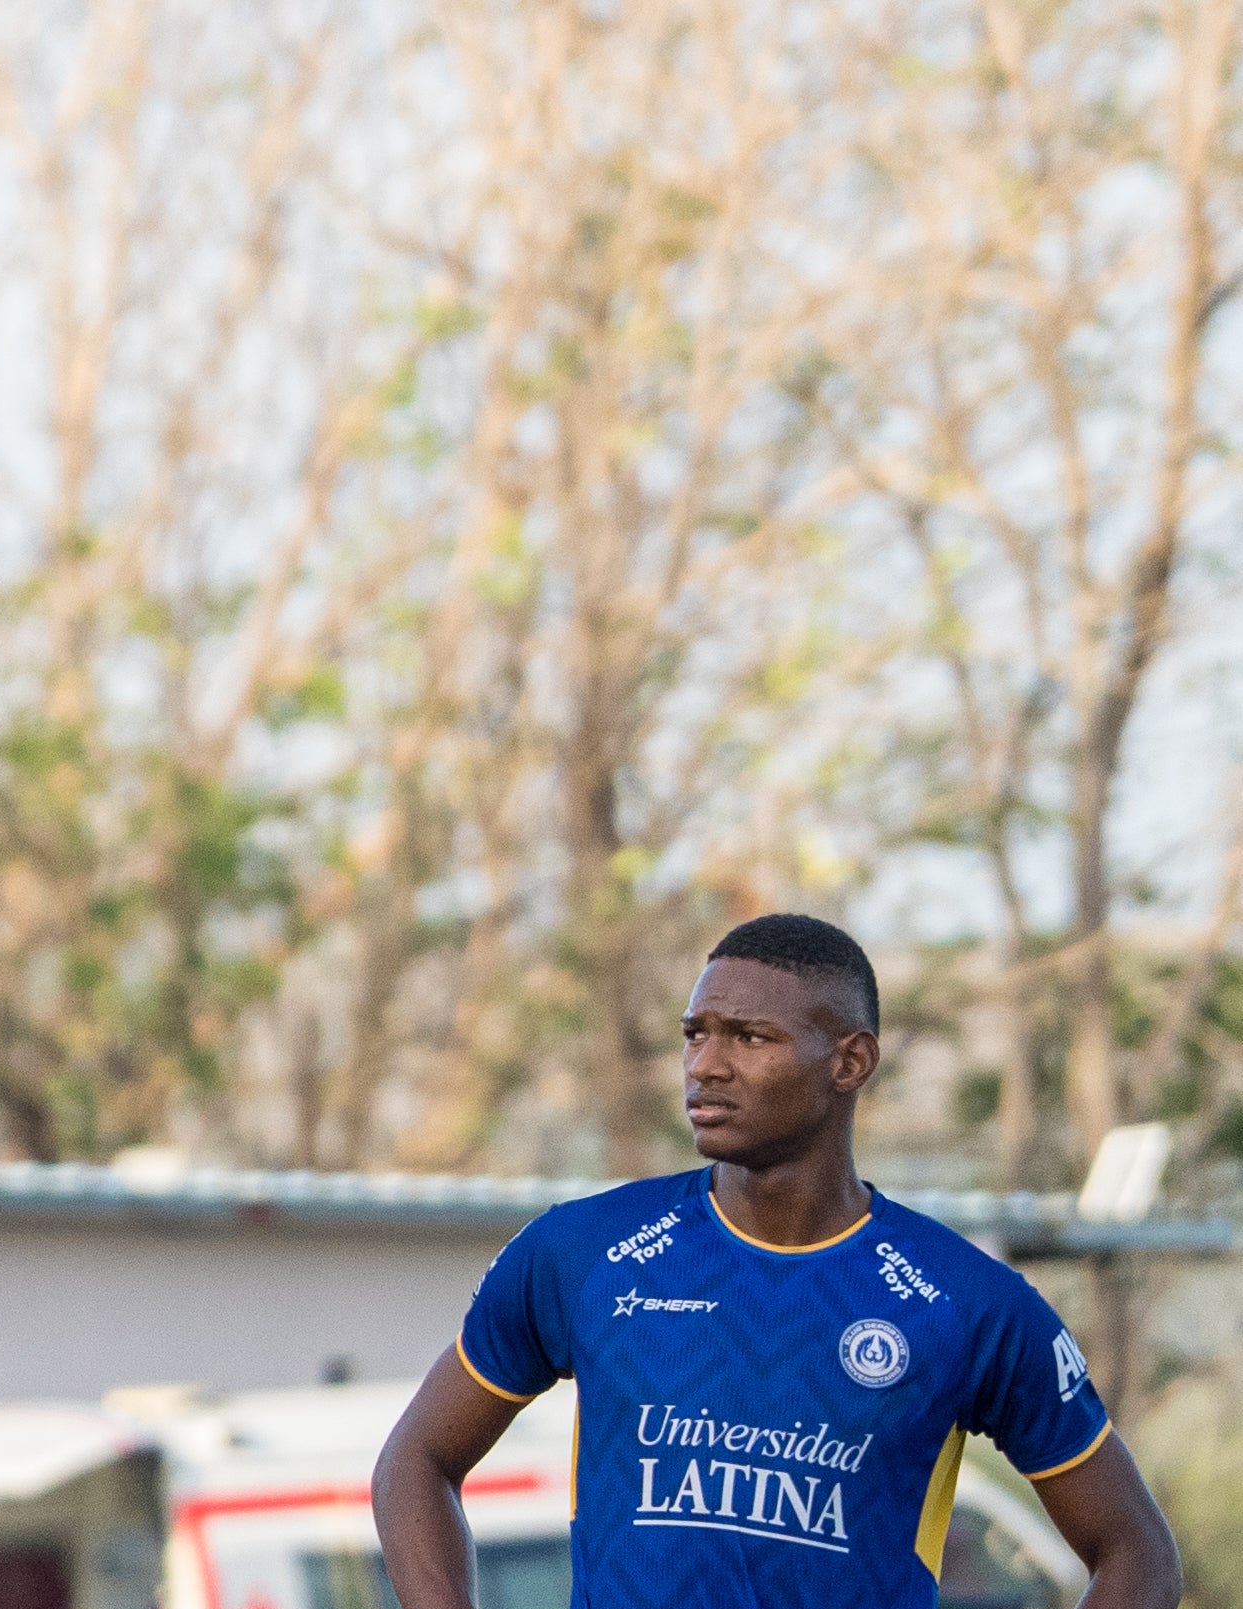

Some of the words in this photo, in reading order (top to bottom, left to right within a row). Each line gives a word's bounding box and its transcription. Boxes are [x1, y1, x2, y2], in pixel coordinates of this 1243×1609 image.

[606, 1211, 681, 1262] Carnival
[630, 1233, 674, 1265] Toys
[875, 1242, 941, 1304] Carnival
[877, 1261, 914, 1300] Toys
[642, 1298, 720, 1313] SHEFFY
[637, 1404, 874, 1474] Universidad
[635, 1458, 850, 1541] LATINA
